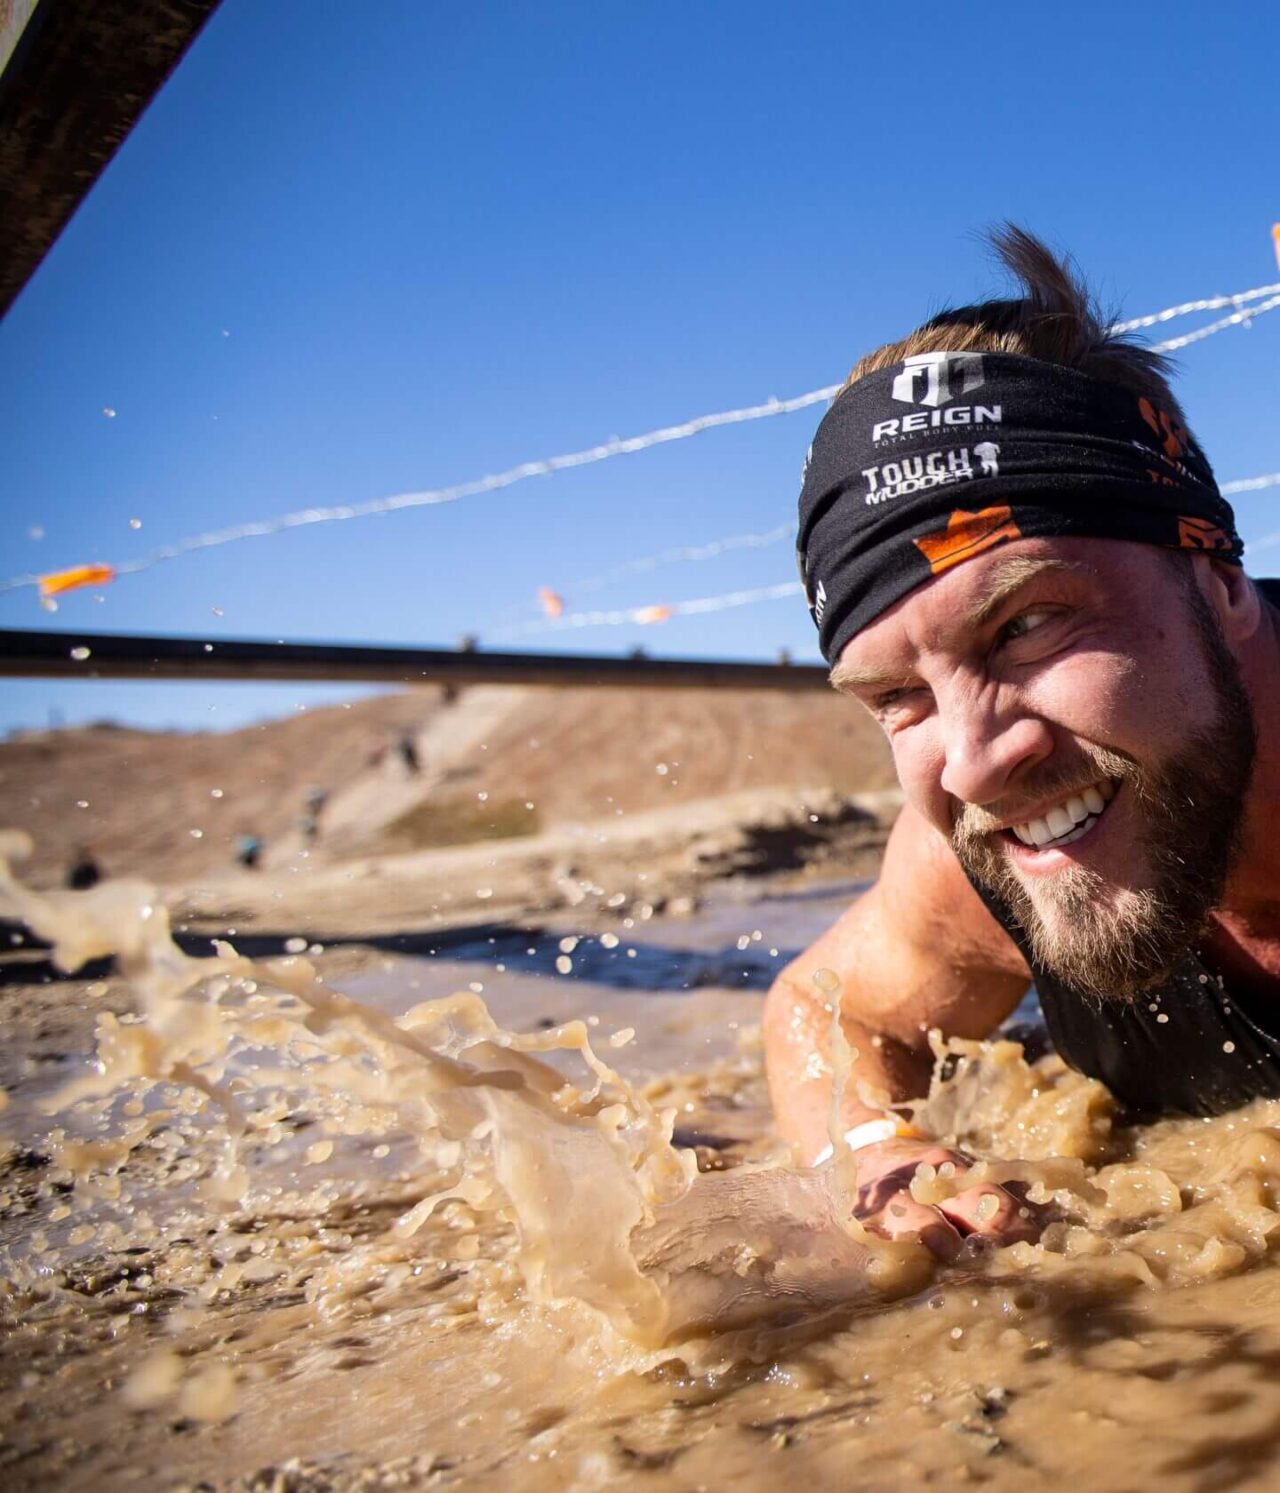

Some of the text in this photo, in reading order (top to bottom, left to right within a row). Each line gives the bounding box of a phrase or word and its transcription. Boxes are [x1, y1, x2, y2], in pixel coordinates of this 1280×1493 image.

[872, 404, 1002, 442] REIGN
[874, 432, 917, 449] TOTAL
[861, 447, 970, 493] TOUGH
[865, 467, 974, 506] MUDDER
